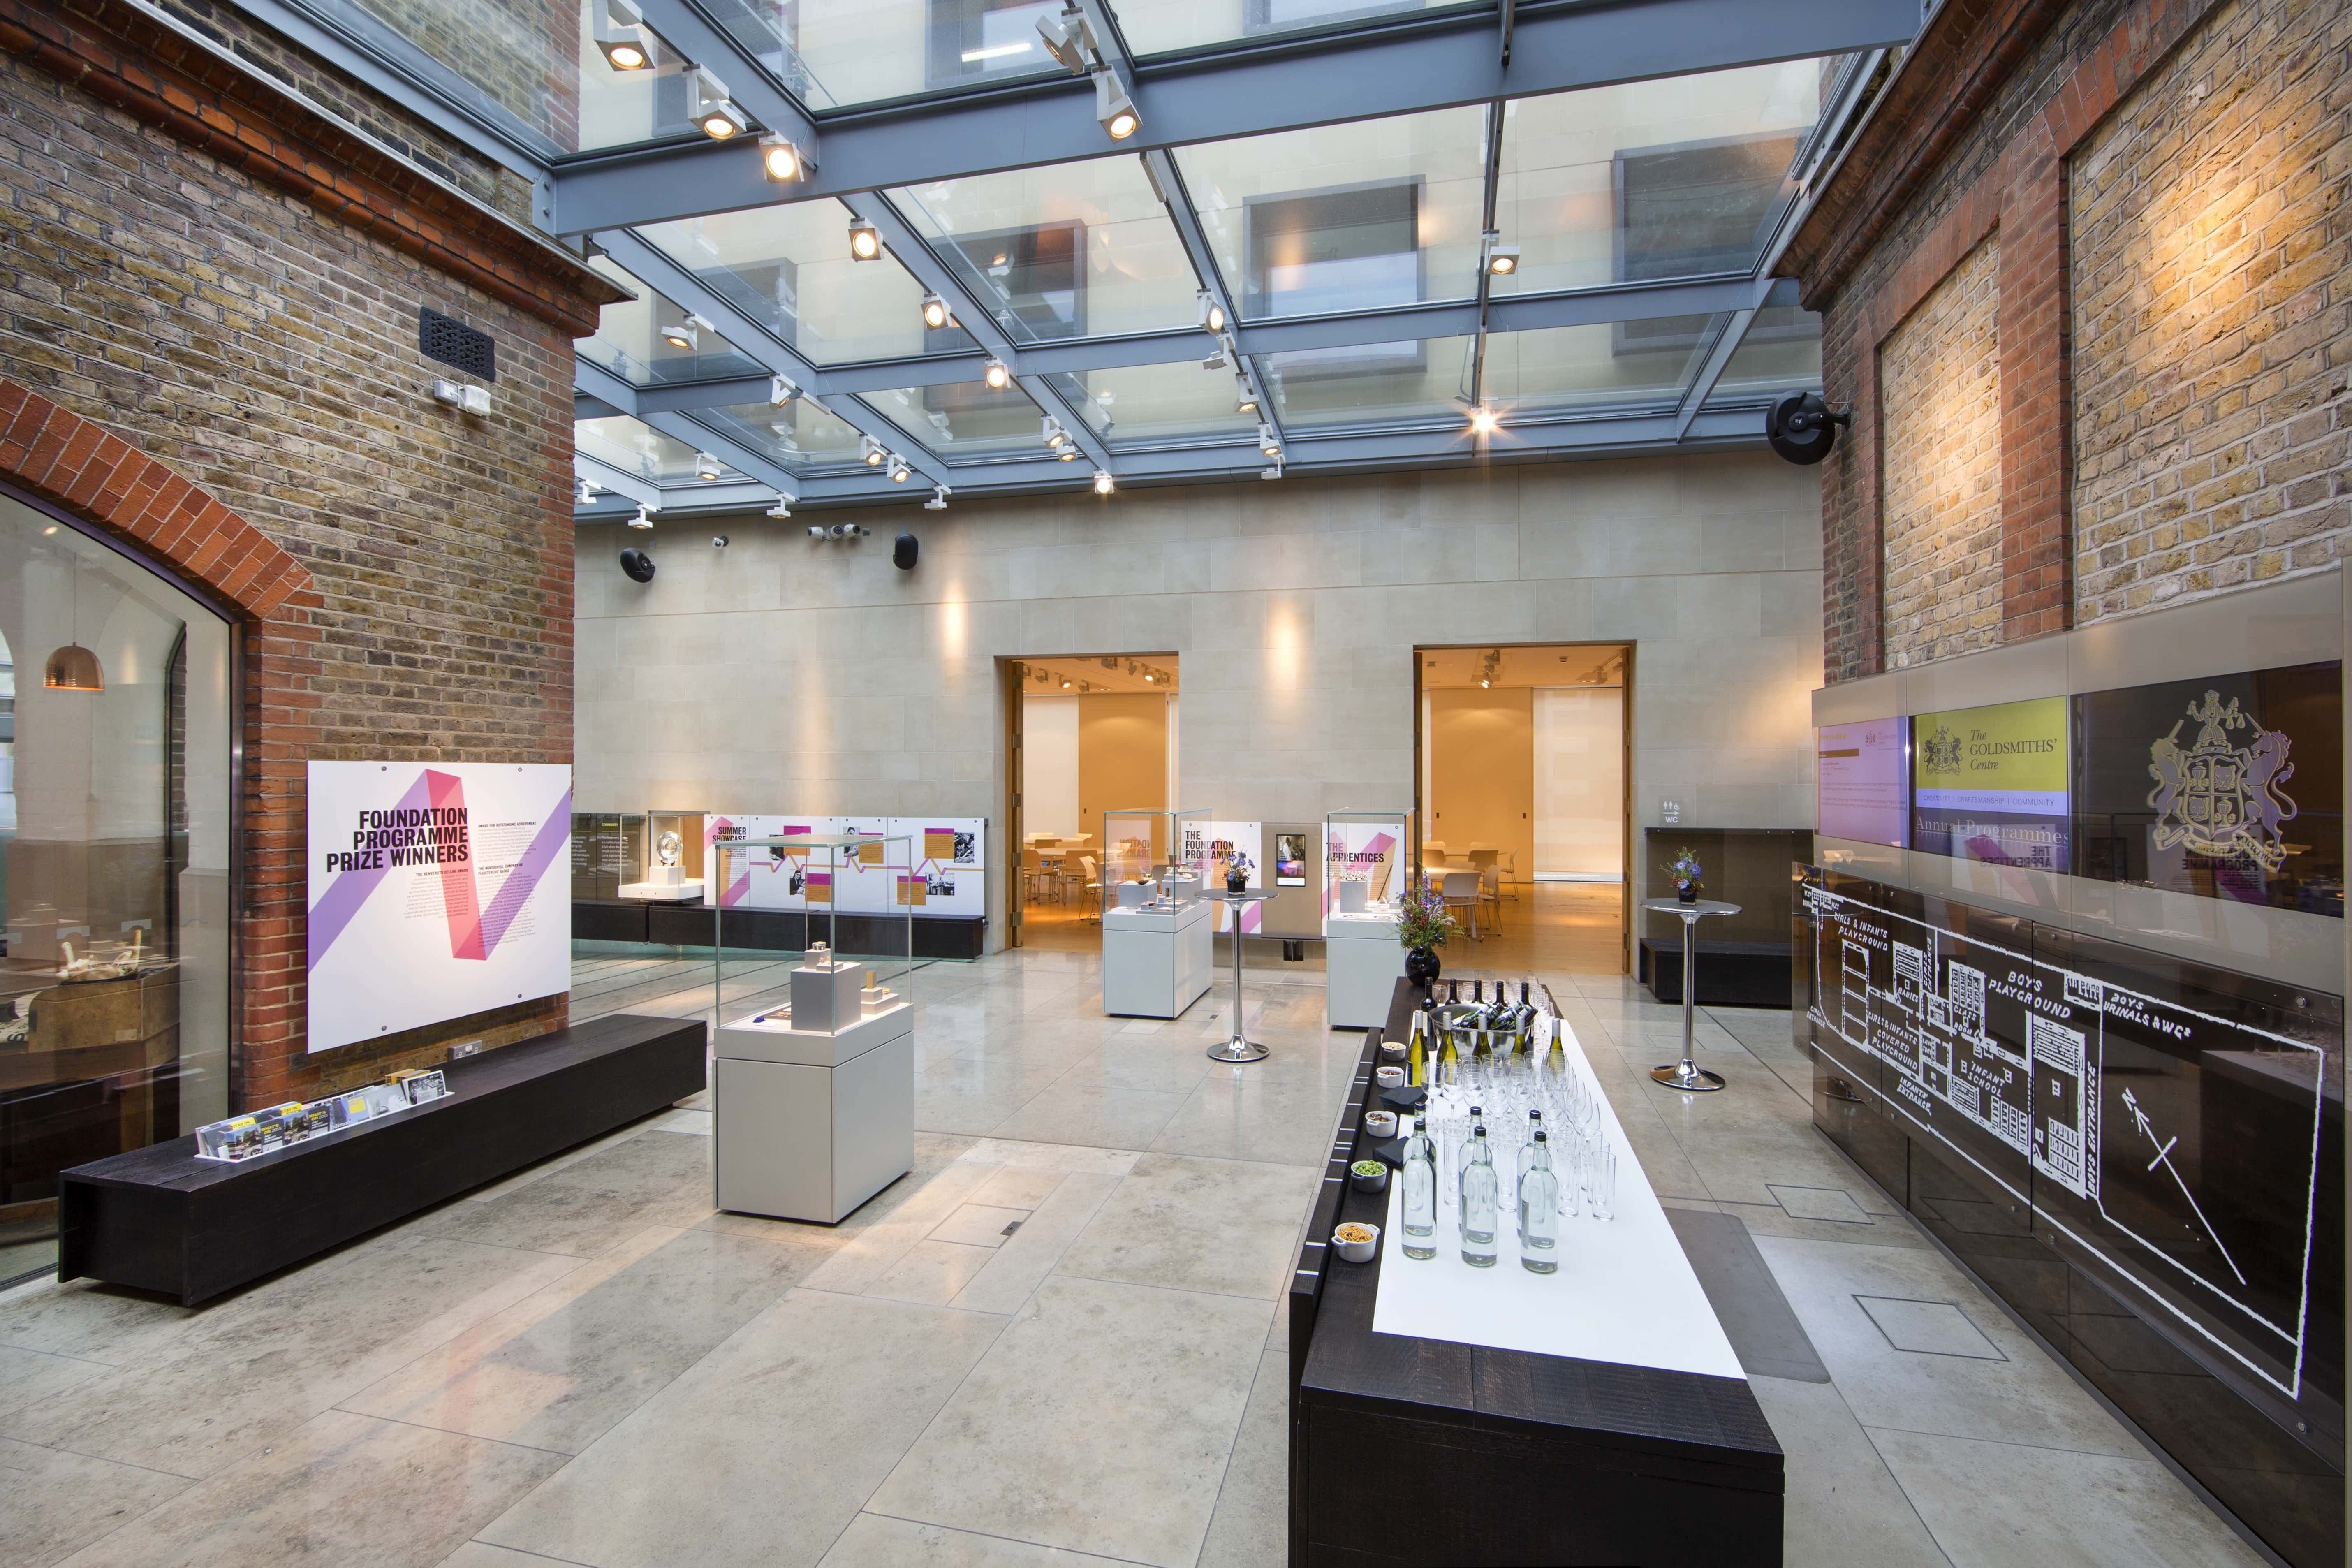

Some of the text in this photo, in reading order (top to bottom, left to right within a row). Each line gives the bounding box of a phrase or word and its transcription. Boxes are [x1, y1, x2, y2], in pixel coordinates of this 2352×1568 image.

[1970, 730, 1986, 741] The
[1970, 739, 2057, 756] GOLDSMITHS'
[1970, 759, 1999, 770] Centre
[359, 808, 468, 829] FOUNDATION
[353, 826, 468, 850] PROGRAMME
[718, 827, 746, 835] SUMMER
[1185, 831, 1200, 840] THE
[1916, 816, 2068, 845] Annual Programmes
[1185, 840, 1234, 850] FOUNDATION
[1185, 850, 1236, 859] PROGRAMME
[1326, 842, 1343, 852] THE
[326, 850, 383, 873] PRIZE
[390, 844, 468, 867] WINNERS
[1326, 853, 1384, 863] APPRENTICES
[1834, 912, 1888, 938] GIRLS & INFANTS
[1838, 926, 1887, 951] PLAYGROUND
[1989, 979, 2071, 1019] PLAYGROUND
[2111, 992, 2145, 1010] BOYS
[1954, 1005, 1977, 1021] CLASS
[2103, 1001, 2150, 1028] URINALS
[1954, 1022, 1972, 1035] ROOM
[1877, 1030, 1910, 1053] COVERED
[1872, 1037, 1918, 1070] PLAYGROUND
[1968, 1072, 2002, 1097] SCHOOL
[1972, 1061, 2005, 1087] INFANT
[2122, 1087, 2137, 1111] N
[2088, 1061, 2096, 1194] BOYS ENTRANCE
